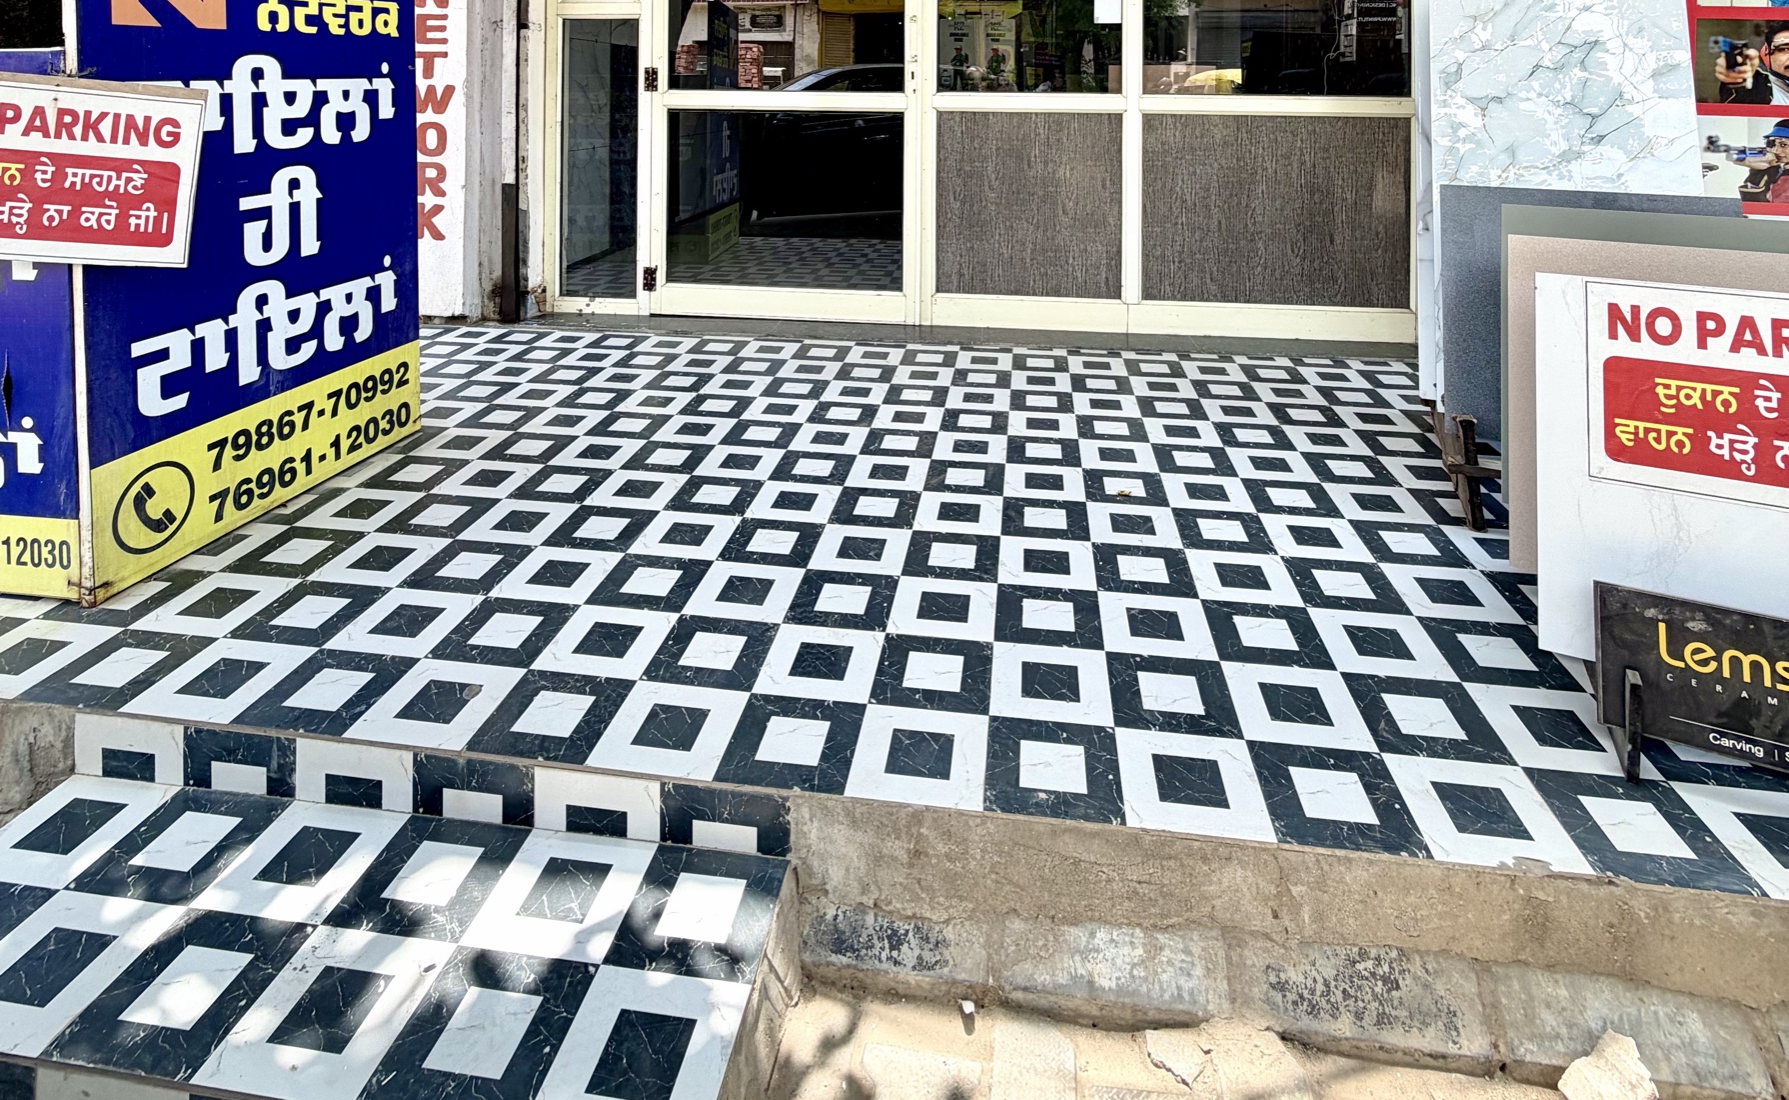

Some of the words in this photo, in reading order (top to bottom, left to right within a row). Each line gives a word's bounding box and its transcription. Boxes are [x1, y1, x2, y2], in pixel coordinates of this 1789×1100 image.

[0, 102, 182, 149] PARKING
[34, 156, 56, 188] ਦੇ
[64, 164, 148, 195] ਸਾਹਮਣੇ
[42, 204, 71, 227] ਨਾ
[80, 198, 119, 231] ਕਰੋ
[239, 165, 323, 267] ਹੀ
[131, 254, 398, 418] ਟਾਇਲਾਂ
[1607, 302, 1682, 346] NO
[1696, 310, 1789, 358] PAR
[207, 361, 410, 473] 79867-70992
[1654, 377, 1740, 414] ਦੁਕਾਨ
[1754, 379, 1782, 419] ਦੇ
[1614, 418, 1694, 454] ਵਾਹਨ
[208, 401, 411, 524] 76961-12030
[1, 536, 72, 570] 12030
[1658, 621, 1789, 692] Lems
[1666, 673, 1779, 706] CERAM
[1709, 732, 1764, 758] Carving
